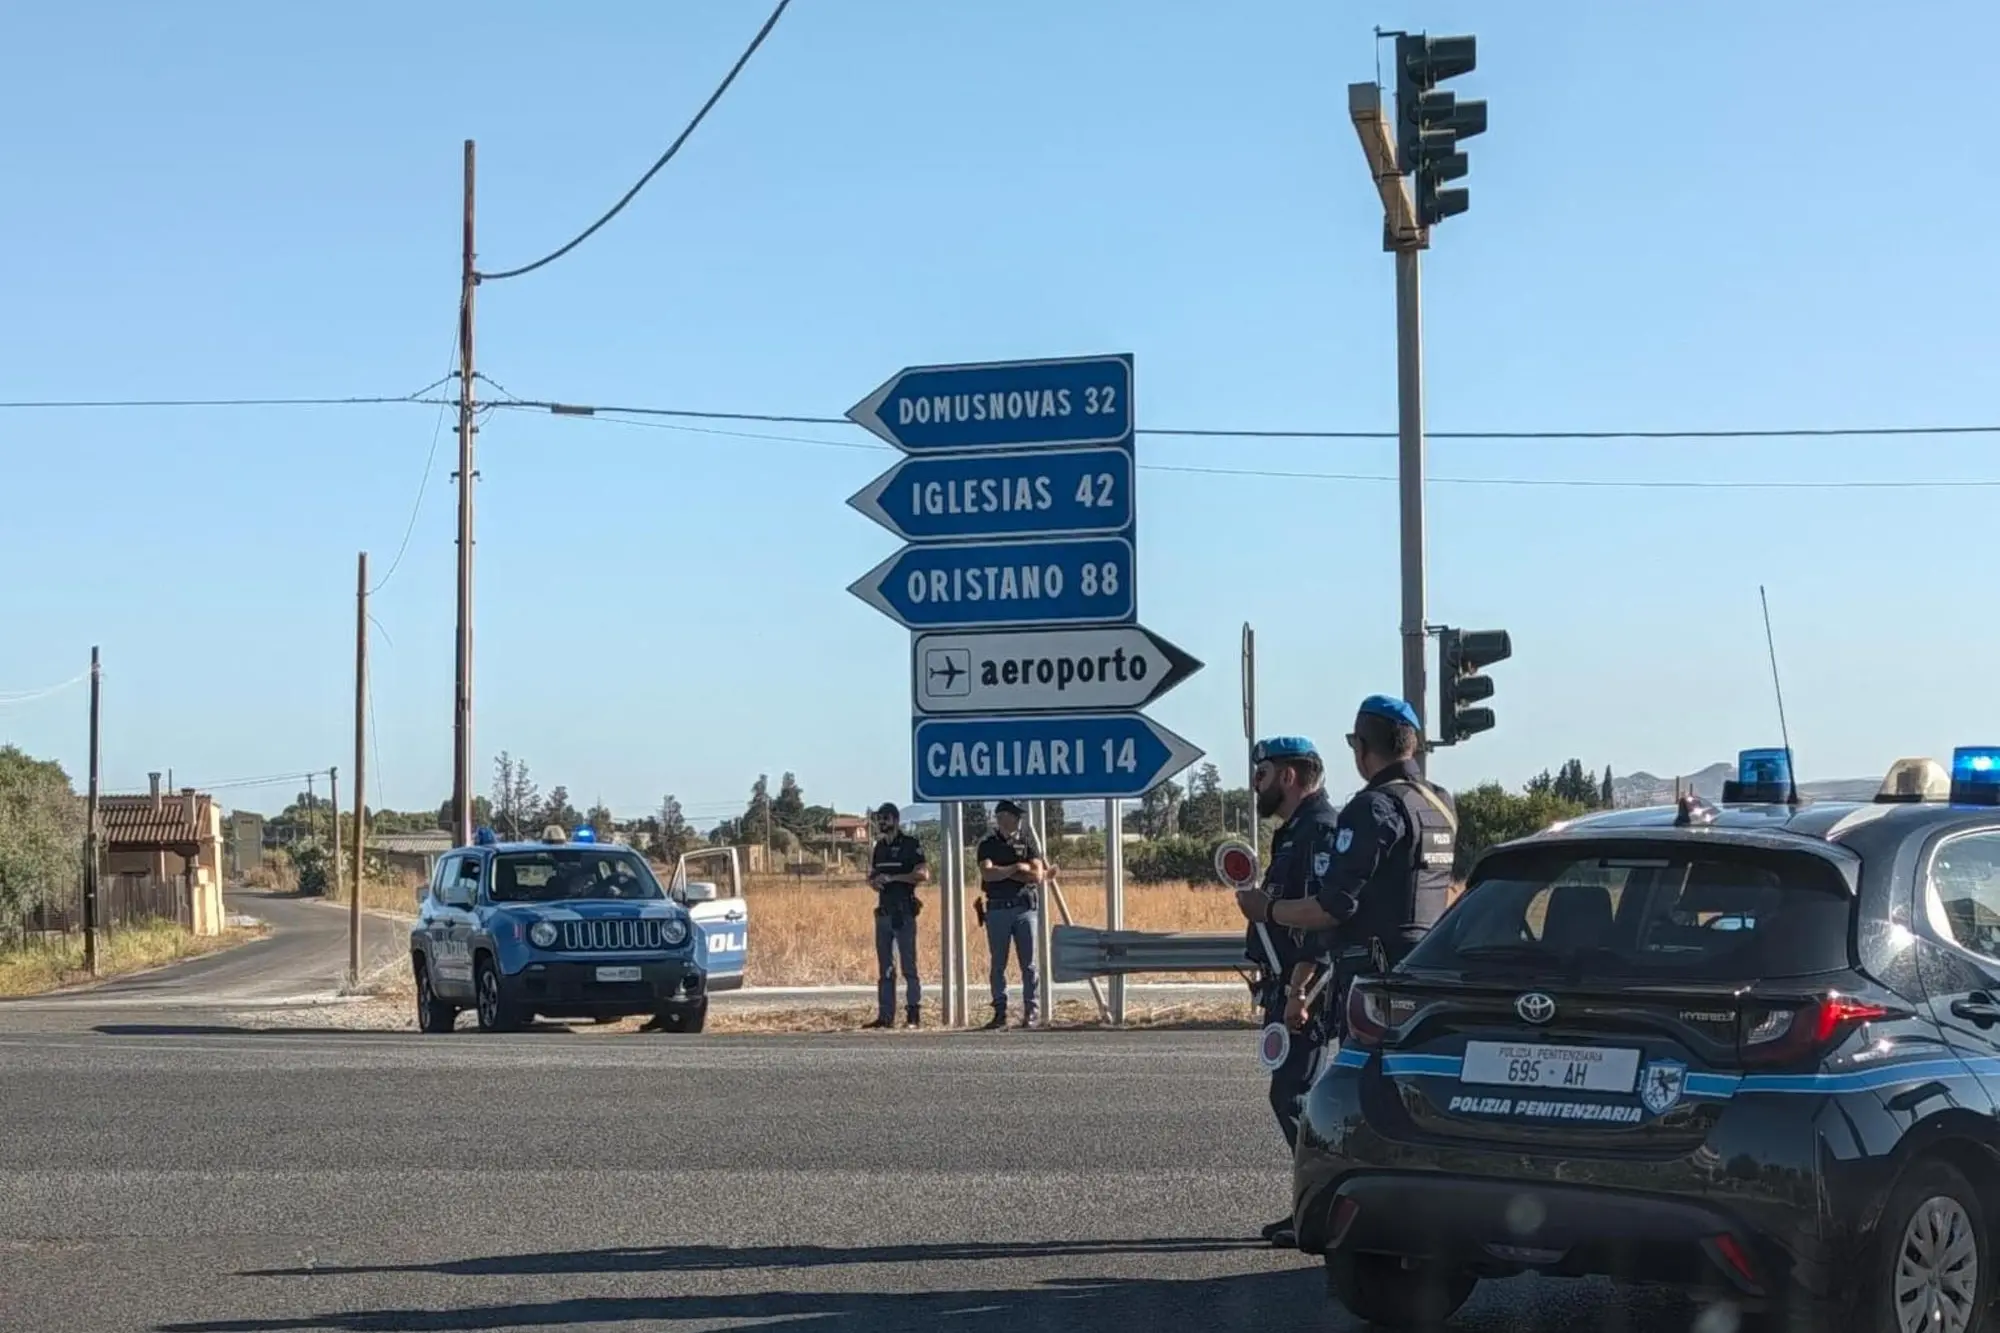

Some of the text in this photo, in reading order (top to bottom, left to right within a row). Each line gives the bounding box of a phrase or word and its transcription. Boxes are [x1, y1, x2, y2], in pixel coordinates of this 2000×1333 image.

[899, 386, 1116, 425] DOMUSNOVAS 32
[912, 473, 1115, 515] IGLESIAS 42
[907, 562, 1119, 602] ORISTANO 88
[980, 647, 1148, 690] aeroporto
[926, 738, 1138, 777] CAGLIARI 14
[1507, 1059, 1588, 1086] 695 AH
[1448, 1096, 1643, 1123] POLIZIA PENITENZIARIA
